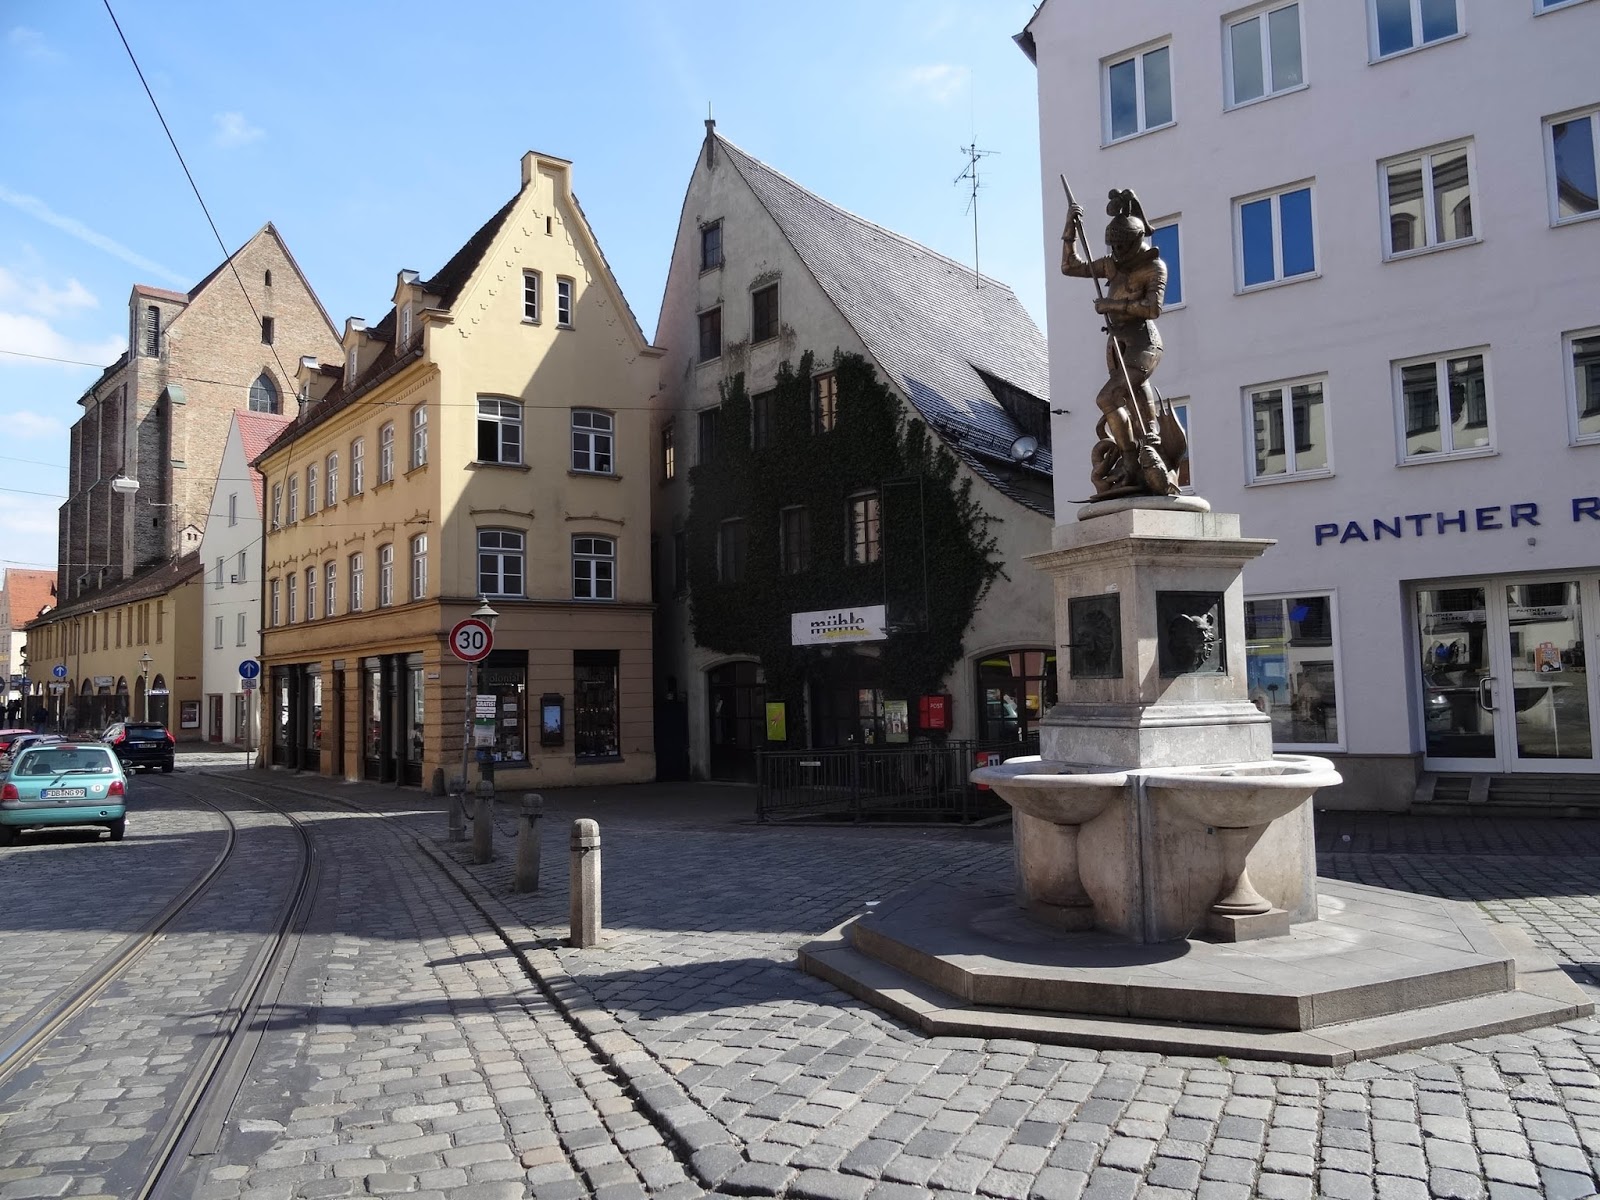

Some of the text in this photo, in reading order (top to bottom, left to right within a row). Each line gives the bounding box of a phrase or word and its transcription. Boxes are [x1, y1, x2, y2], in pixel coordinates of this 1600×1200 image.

[1314, 502, 1542, 547] PANTHER
[810, 612, 865, 635] mühle
[459, 630, 484, 650] 30
